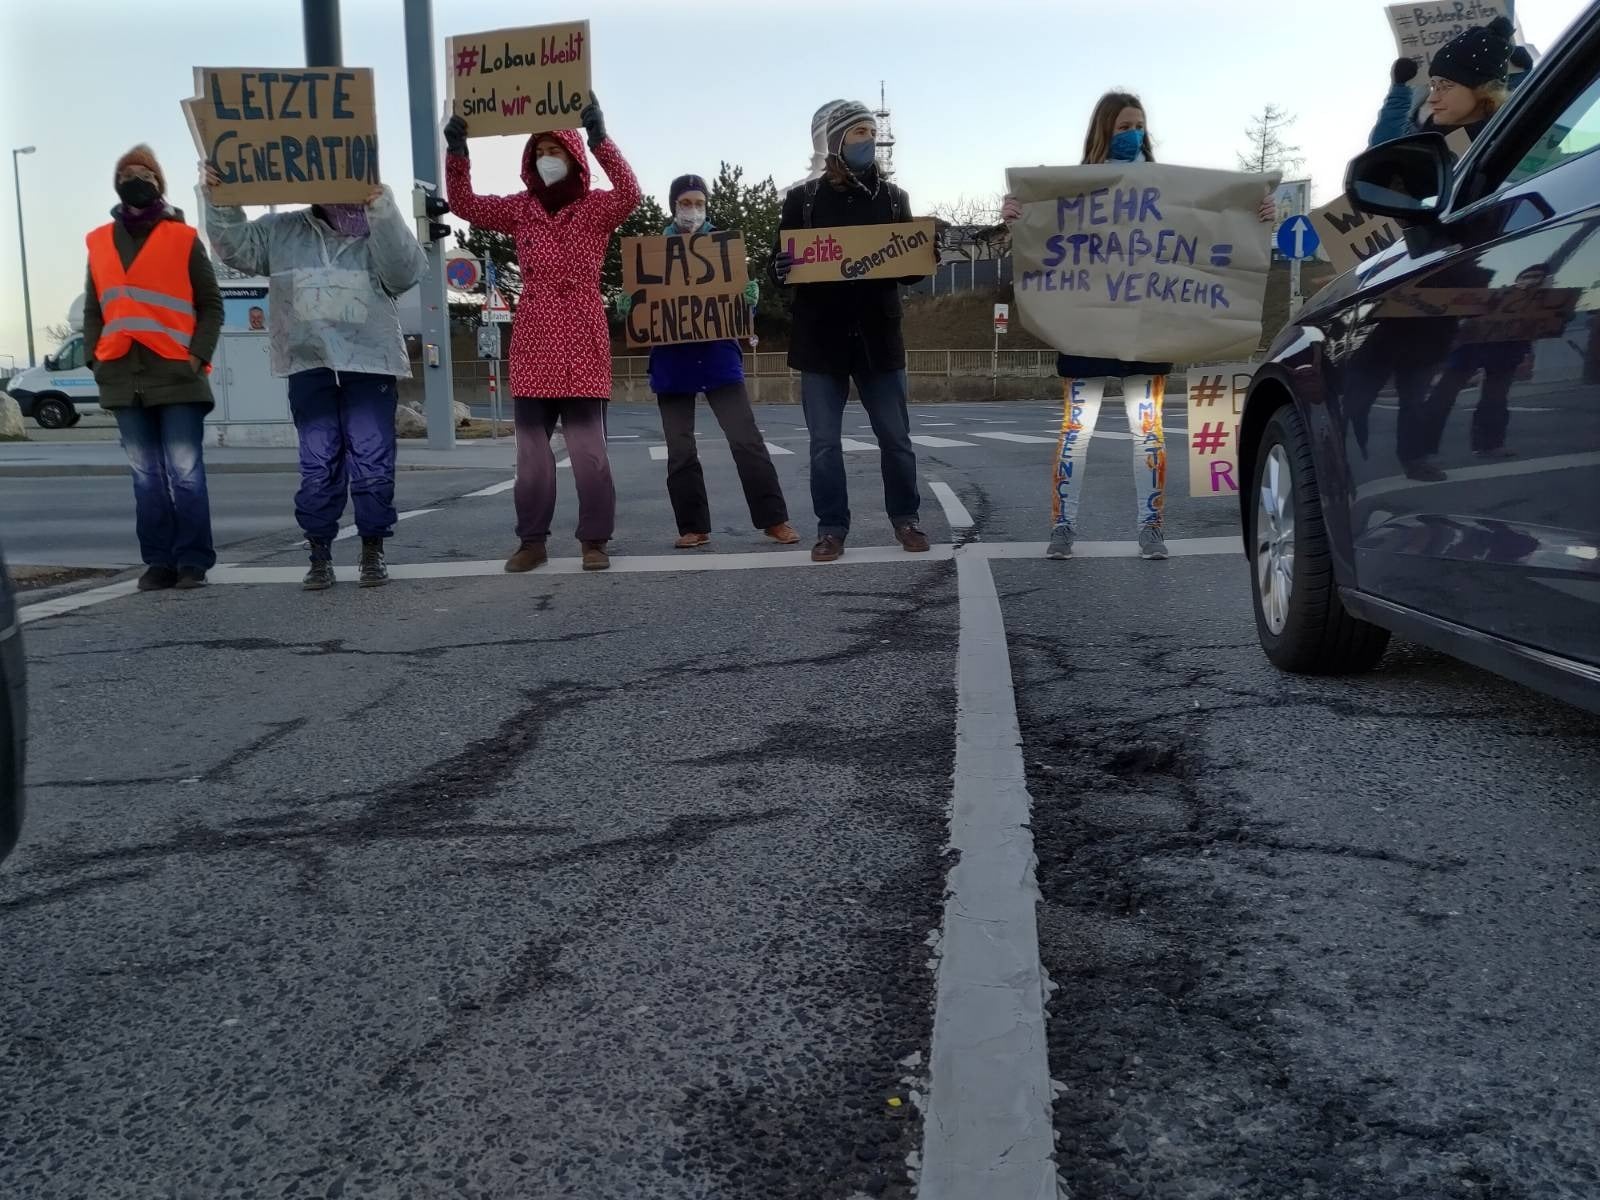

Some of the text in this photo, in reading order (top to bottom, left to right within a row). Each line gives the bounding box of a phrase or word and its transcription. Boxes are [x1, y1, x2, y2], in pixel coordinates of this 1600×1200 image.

[456, 32, 584, 76] #Lobau bleibt
[211, 72, 355, 120] LETZTE
[463, 80, 583, 117] sind wir alle
[209, 130, 380, 185] GENERATION
[1057, 187, 1163, 233] MEHR
[636, 230, 742, 286] LAST
[788, 230, 929, 279] Letzte Generation
[1022, 268, 1230, 309] MEHR VERKEHR
[627, 289, 751, 343] GENERATION
